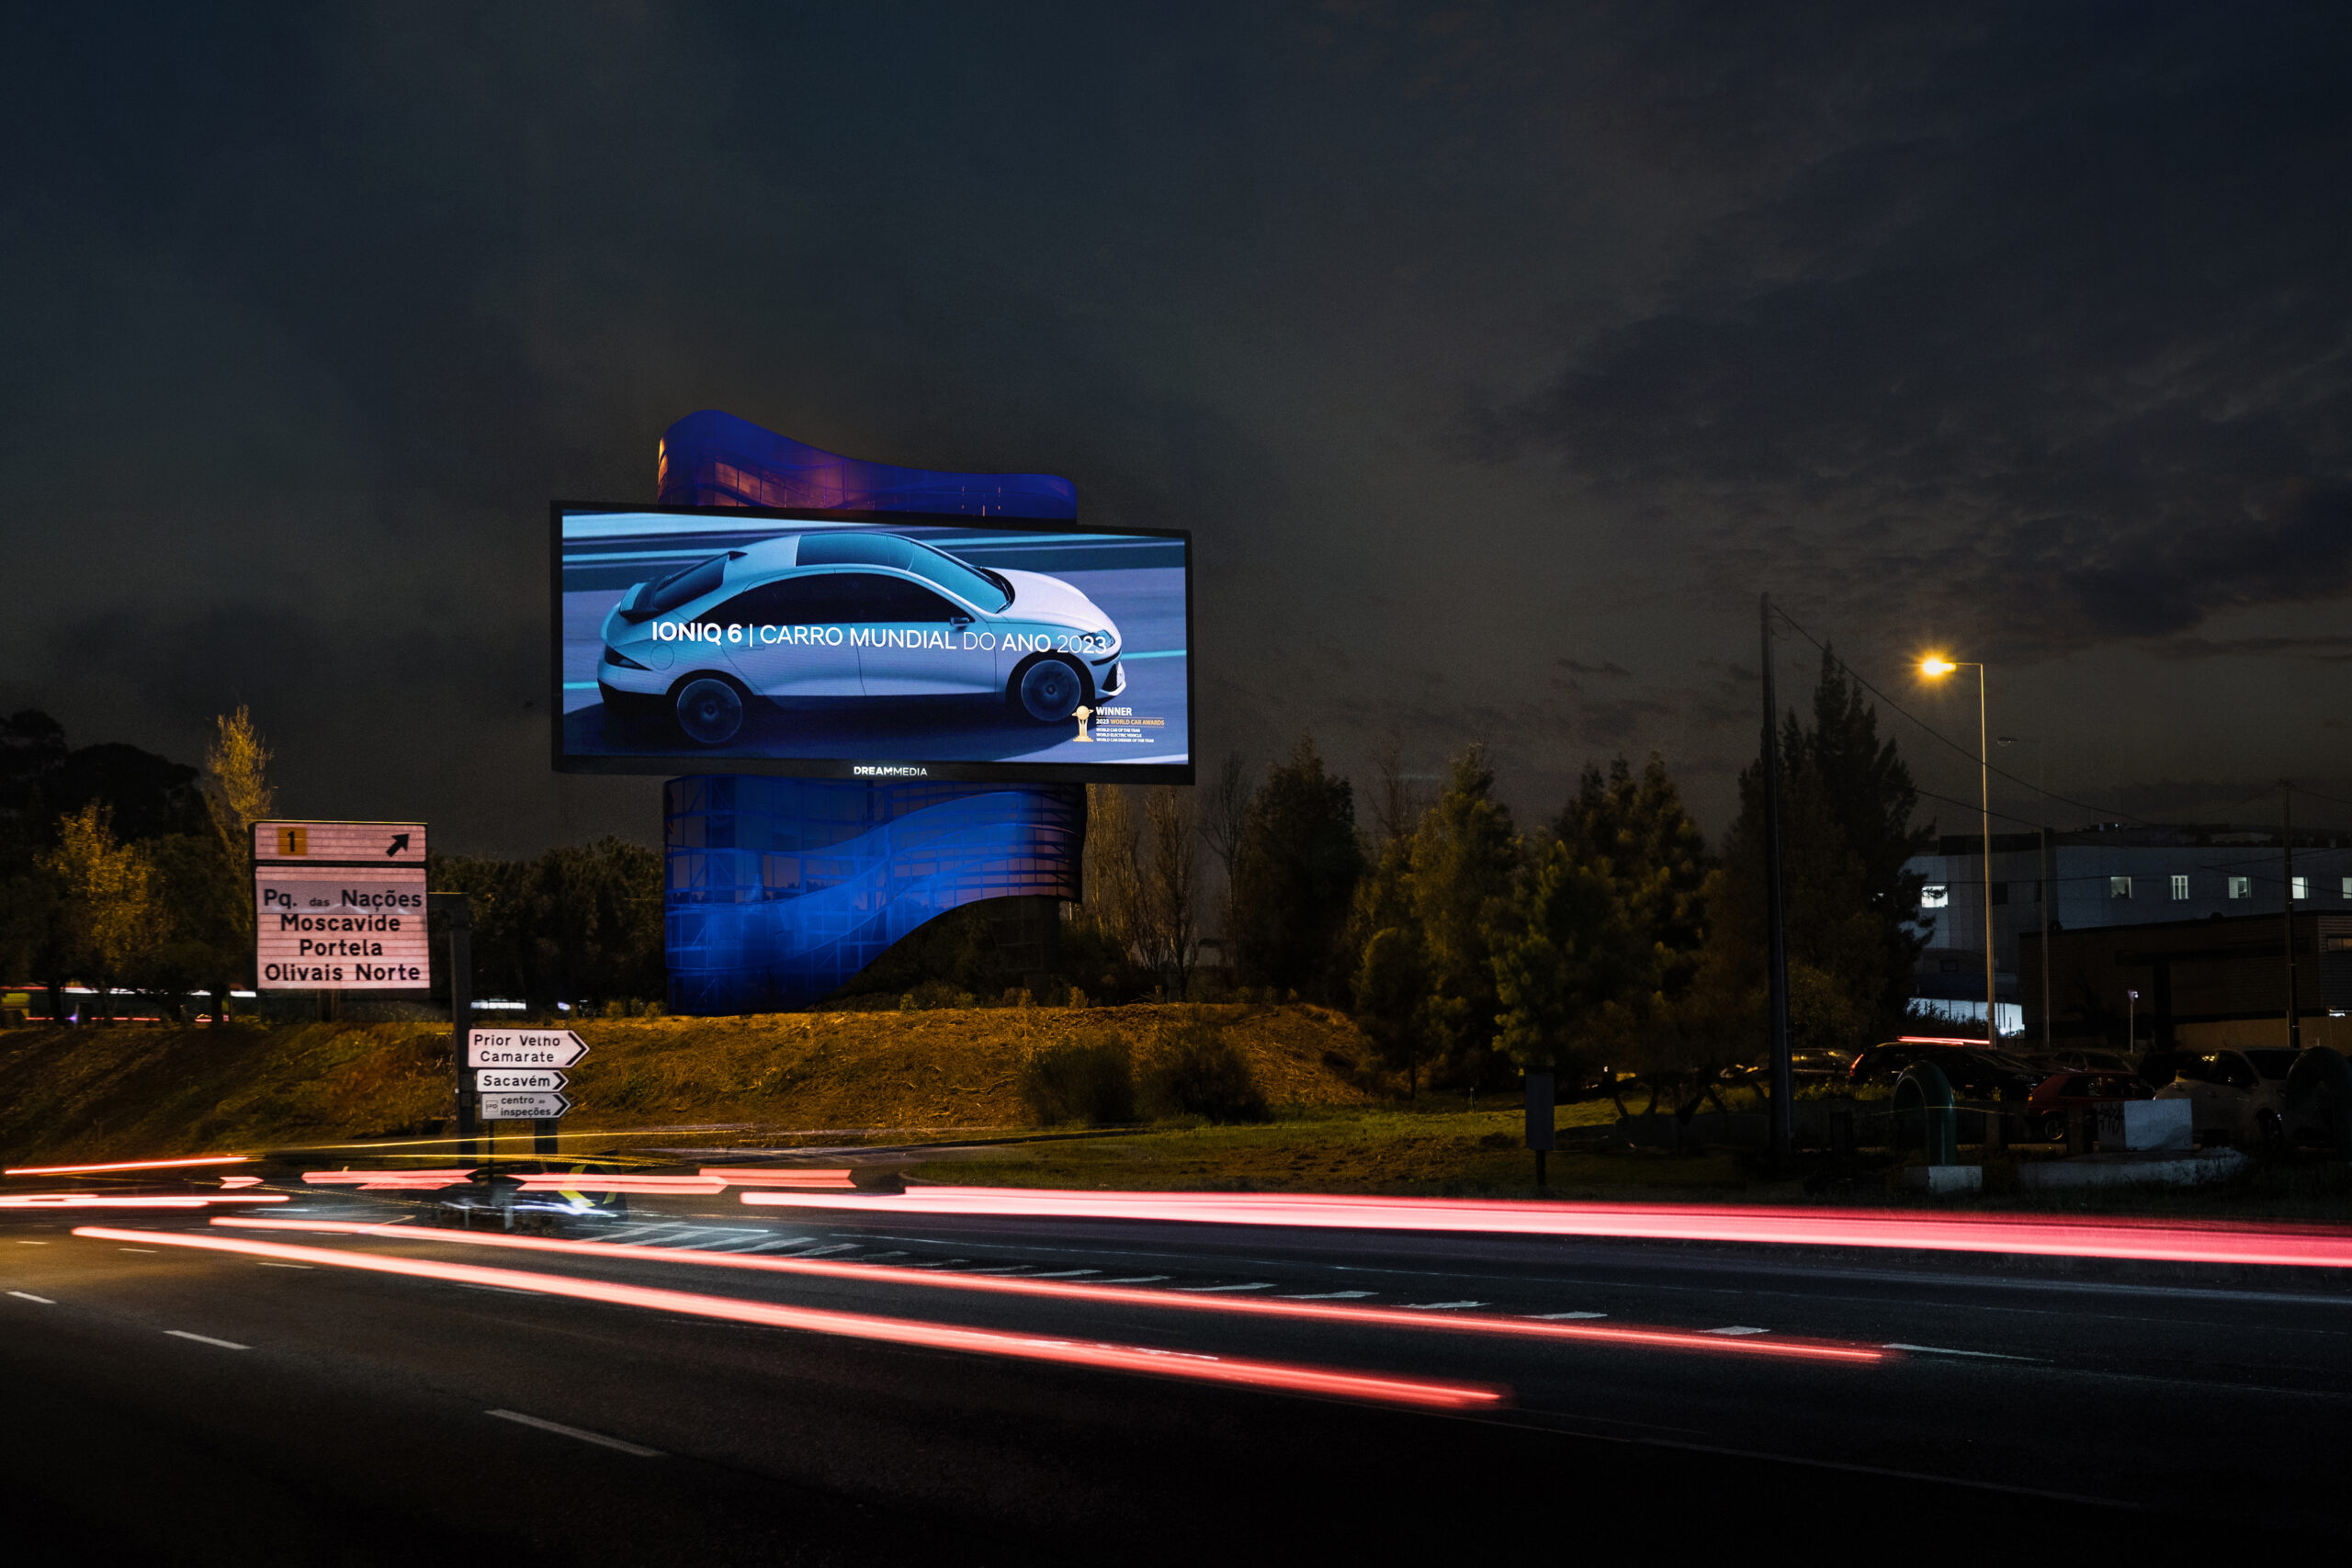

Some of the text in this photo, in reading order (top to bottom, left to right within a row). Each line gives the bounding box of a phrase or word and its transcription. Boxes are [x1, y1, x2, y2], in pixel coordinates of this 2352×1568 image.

[652, 621, 722, 646] IONIQ
[728, 624, 742, 643] 6
[760, 625, 843, 646] CARRO
[850, 628, 957, 650] MUNDIAL
[963, 631, 996, 651] DO
[1001, 634, 1051, 652] ANO
[1057, 635, 1107, 654] 2023
[1095, 706, 1132, 716] WINNER
[287, 831, 295, 852] 1
[264, 889, 422, 912] Pq. das Nações
[280, 914, 401, 931] Moscavide
[300, 939, 382, 956] Portela
[265, 964, 420, 981] Olivais Norte
[474, 1034, 560, 1046] Prior Velho
[481, 1051, 554, 1062] Camarate
[483, 1075, 550, 1087] Sacavém
[501, 1096, 535, 1104] centro
[501, 1107, 551, 1117] inspeções
